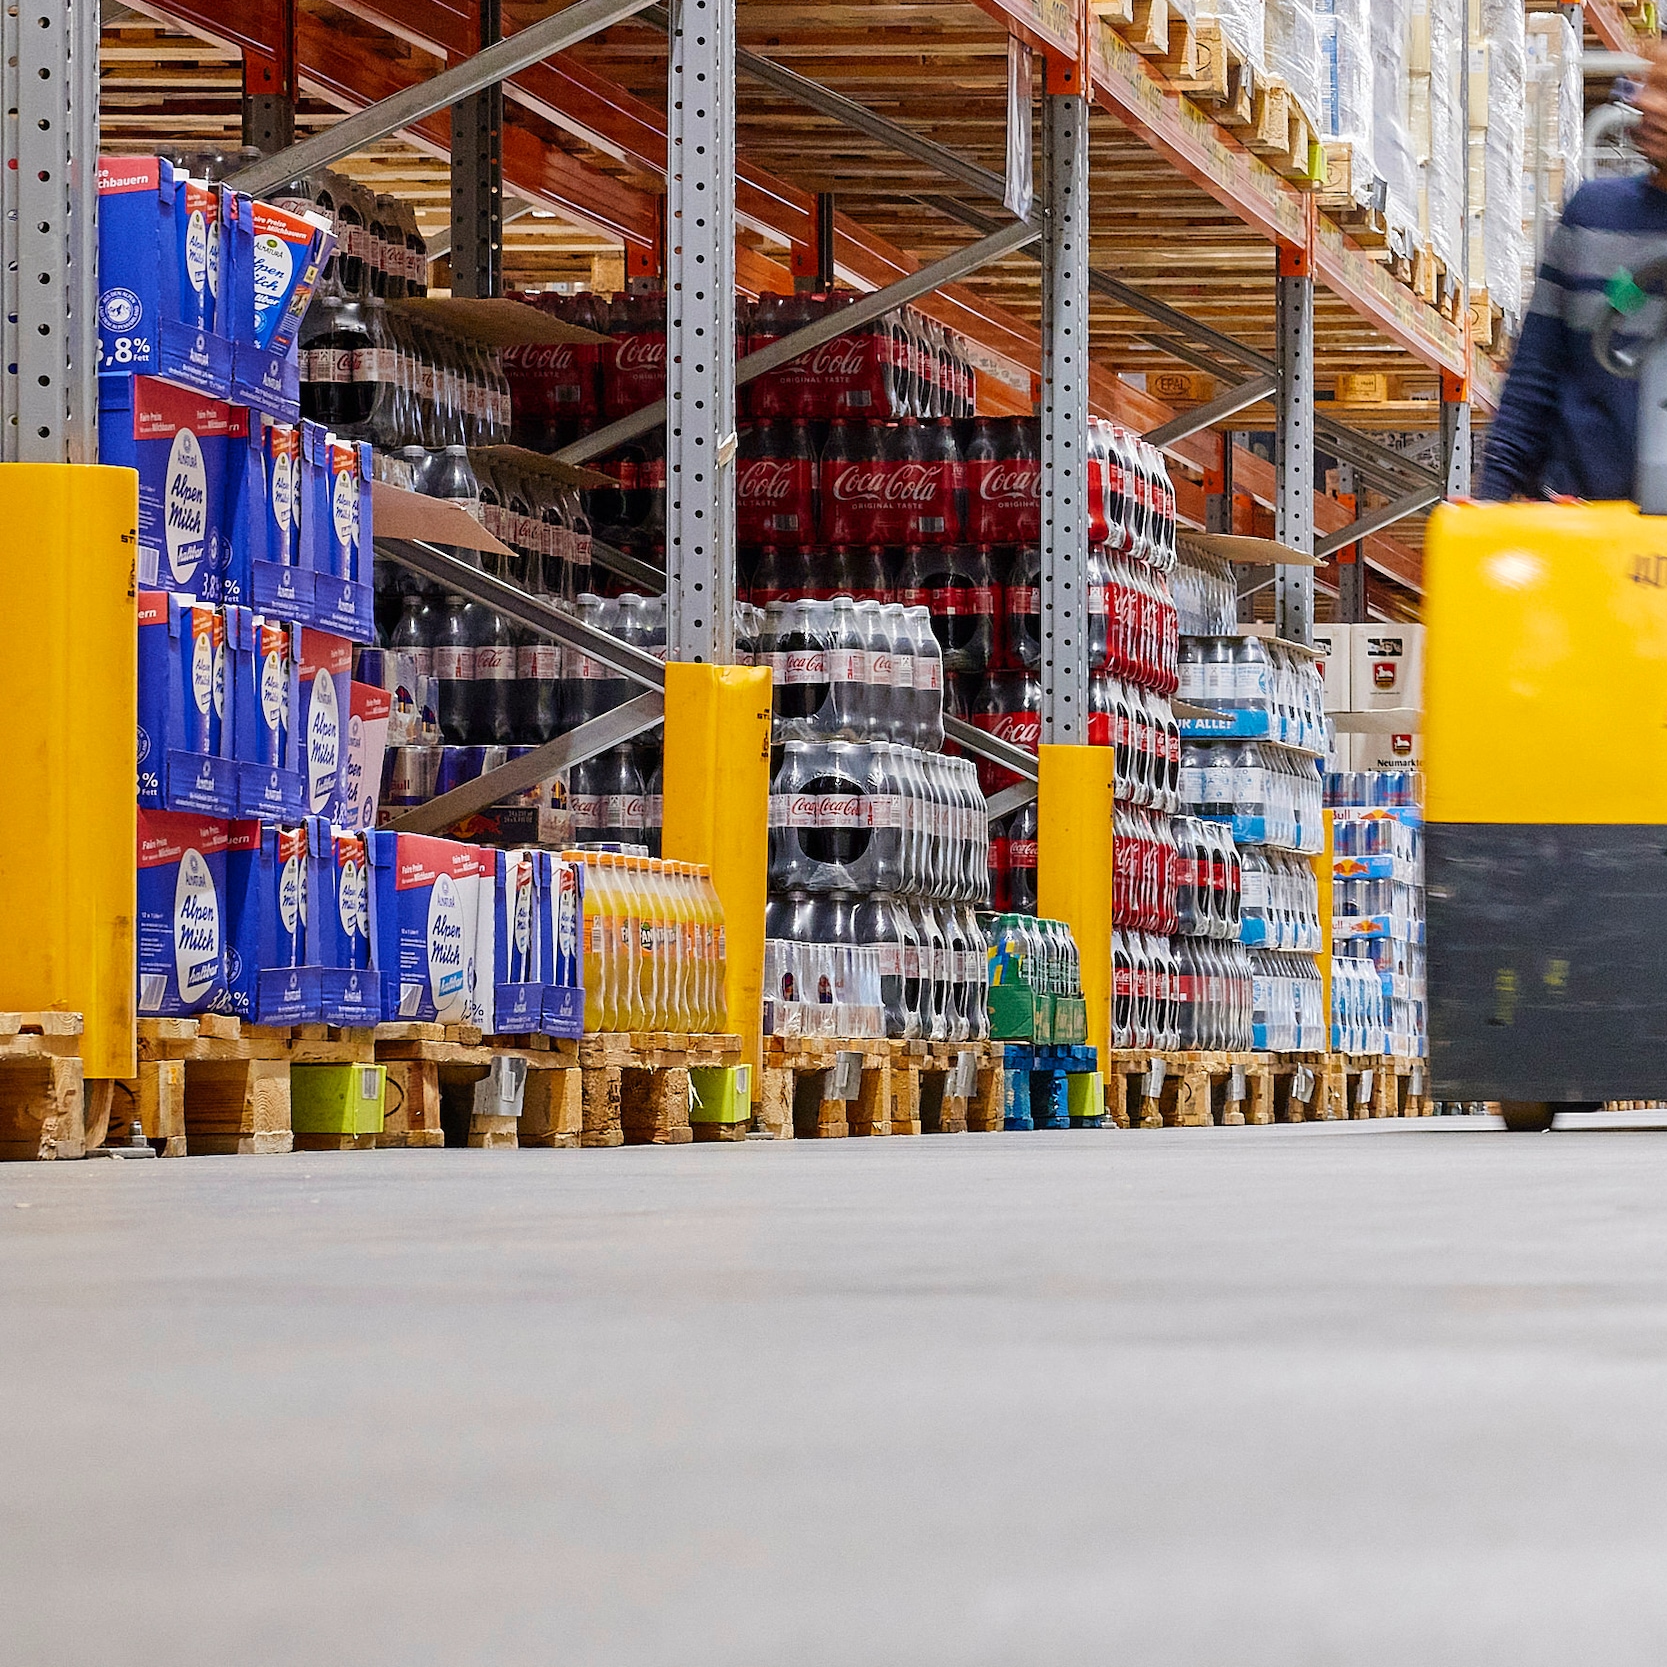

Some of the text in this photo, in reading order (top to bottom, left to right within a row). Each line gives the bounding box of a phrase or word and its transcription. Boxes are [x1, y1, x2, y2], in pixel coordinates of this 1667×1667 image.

[98, 175, 148, 189] chbauern
[253, 216, 286, 228] aire Preise
[266, 226, 308, 239] Milchbauern
[253, 257, 285, 279] lpen
[253, 274, 278, 292] ilch
[134, 338, 150, 353] %
[134, 354, 149, 362] Fett
[171, 473, 203, 505] Alpen
[168, 502, 201, 533] Milch
[225, 580, 240, 594] %
[313, 712, 336, 738] Alpen
[312, 740, 335, 765] Milch
[1377, 759, 1424, 768] Neumarkte
[142, 773, 158, 787] %
[181, 894, 214, 926] Alpen
[178, 924, 214, 952] Milch
[433, 914, 461, 944] Alpen
[431, 940, 460, 966] Milch
[234, 992, 249, 1006] %
